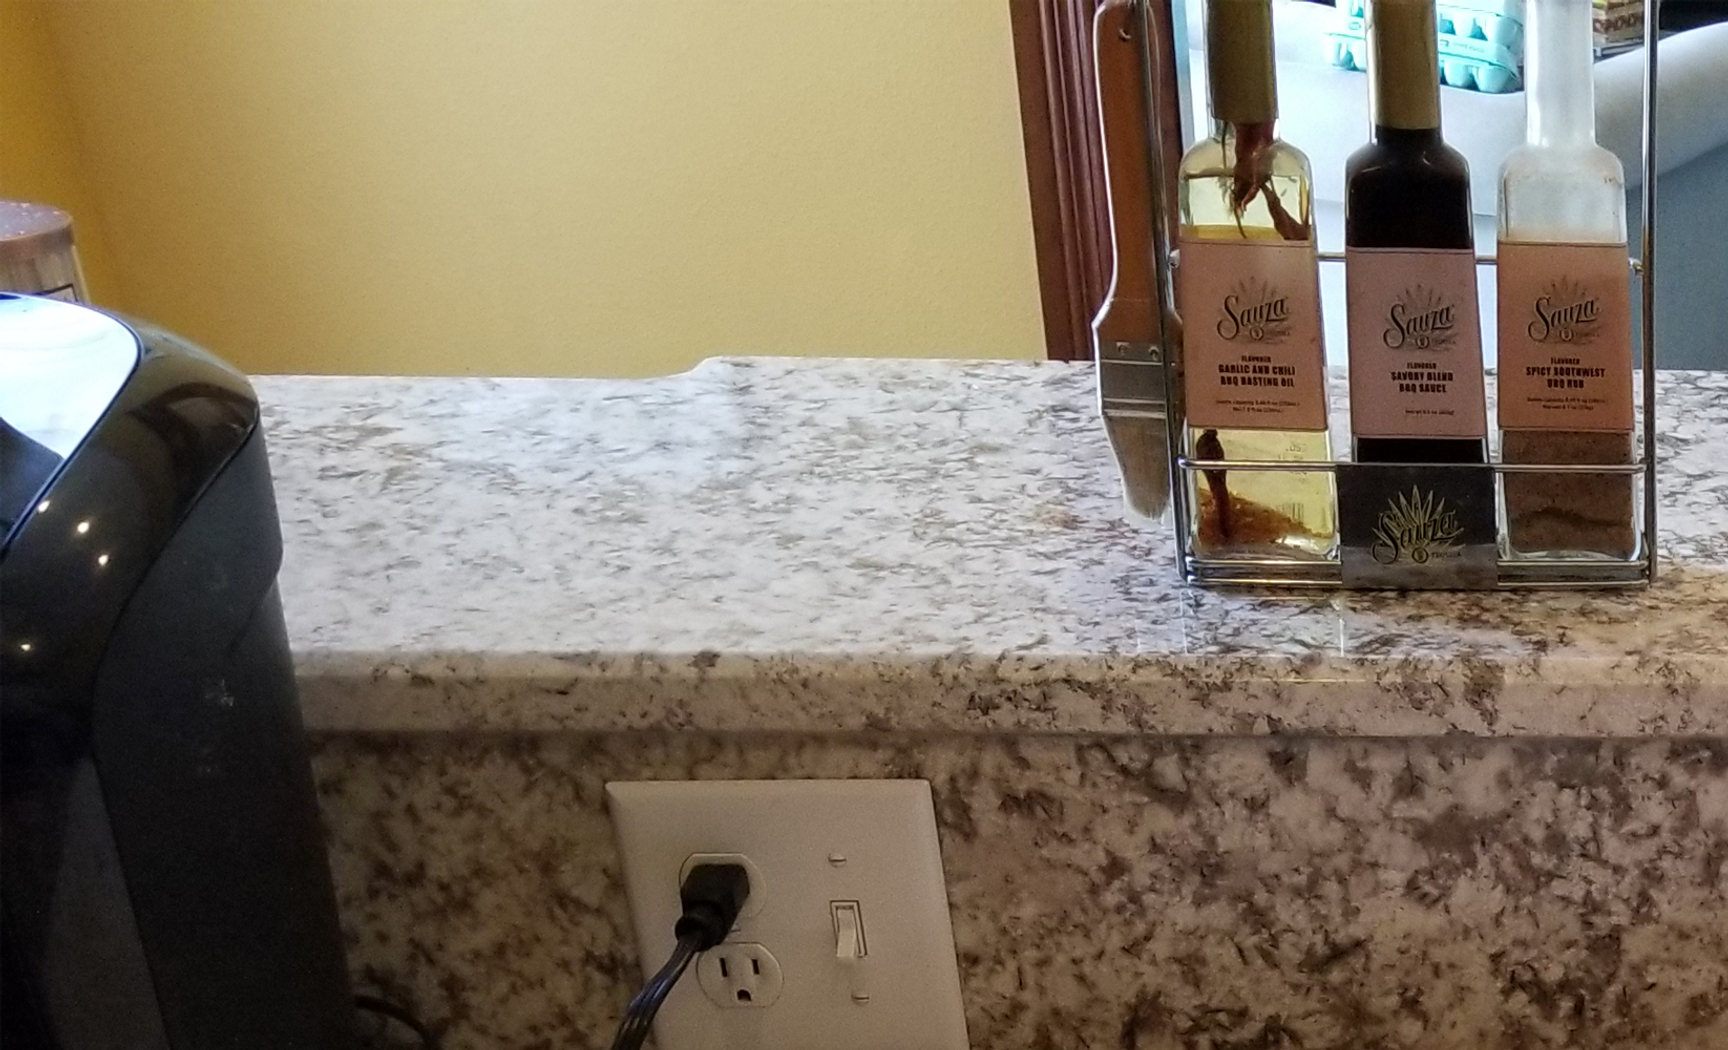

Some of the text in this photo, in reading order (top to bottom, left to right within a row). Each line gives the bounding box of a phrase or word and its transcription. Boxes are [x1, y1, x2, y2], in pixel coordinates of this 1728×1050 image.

[1217, 295, 1289, 340] Sauza
[1528, 296, 1599, 341] Sauza
[1383, 303, 1455, 348] Sauza
[1218, 364, 1296, 376] GARLIC AND CHILI
[1391, 371, 1424, 381] SAVORY
[1526, 366, 1606, 378] SPICY SOUTHWEST
[1241, 376, 1278, 387] BASTING
[1281, 377, 1294, 387] OIL
[1399, 383, 1446, 393] BBQ SAUCE
[1371, 511, 1458, 564] Sauza
